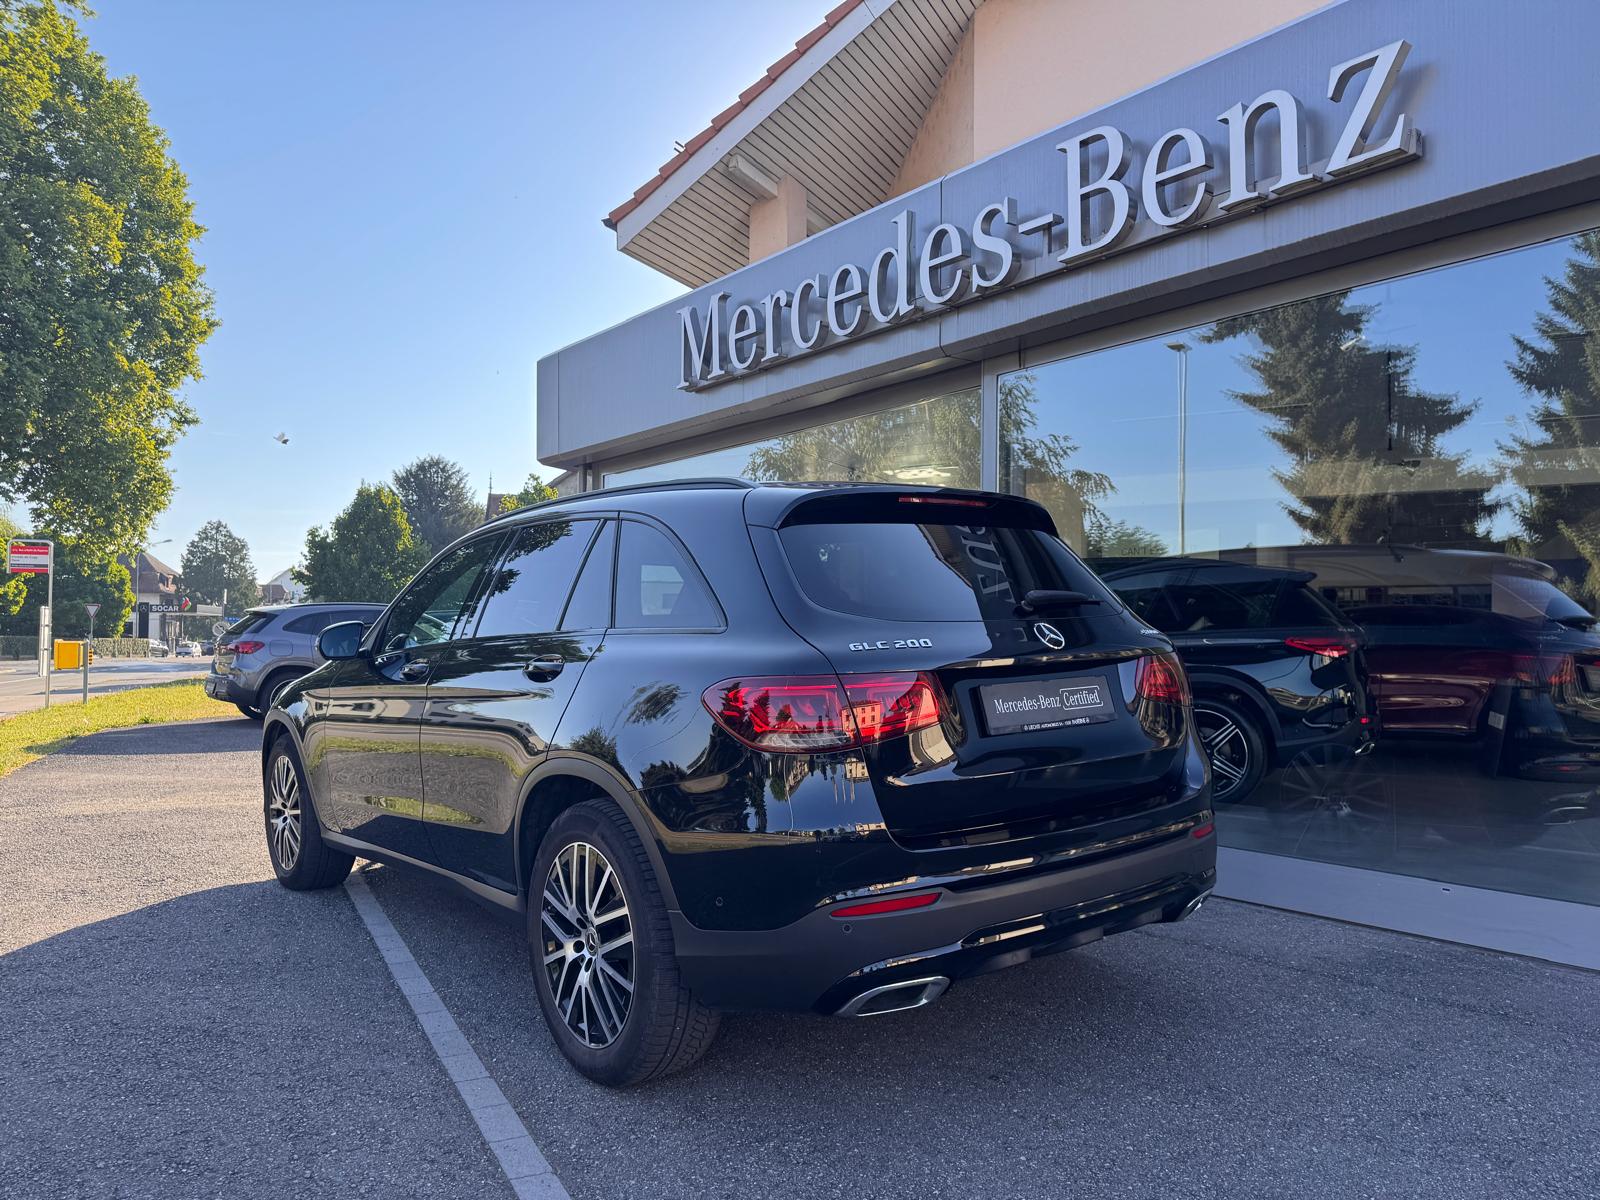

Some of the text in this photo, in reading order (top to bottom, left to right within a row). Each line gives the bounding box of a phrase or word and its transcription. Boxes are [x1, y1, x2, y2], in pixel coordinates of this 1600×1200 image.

[677, 39, 1420, 391] Mercedes-Benz
[849, 638, 933, 651] GLC 200
[994, 689, 1101, 714] Mercedes-Benz Certified
